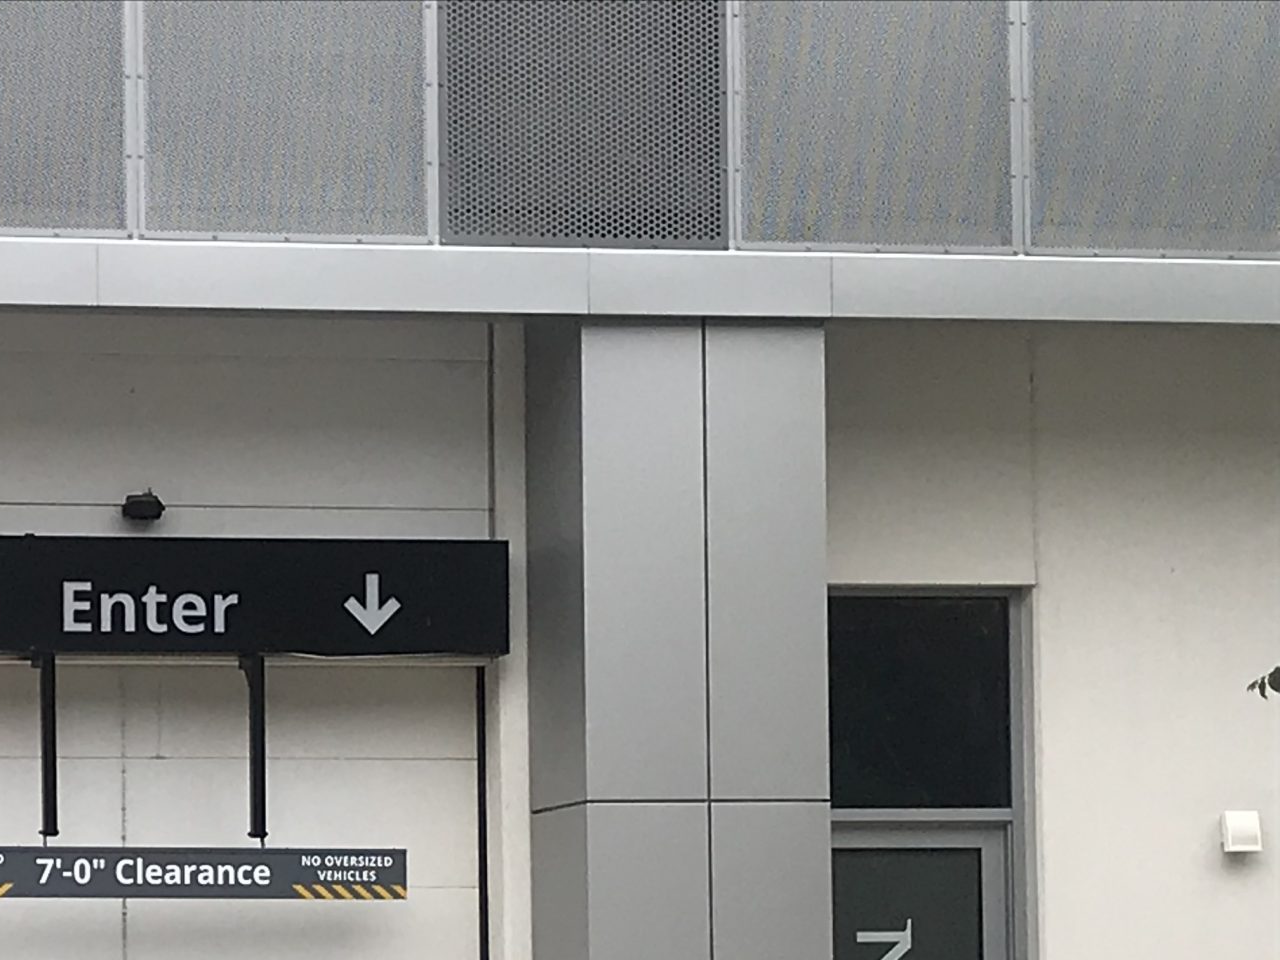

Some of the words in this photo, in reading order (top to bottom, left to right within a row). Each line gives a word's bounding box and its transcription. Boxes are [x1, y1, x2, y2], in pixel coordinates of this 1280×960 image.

[63, 580, 239, 633] Enter
[115, 857, 271, 886] Clearance
[301, 855, 321, 867] NO
[324, 855, 393, 868] OVERSIZED
[317, 869, 377, 882] VEHICLES
